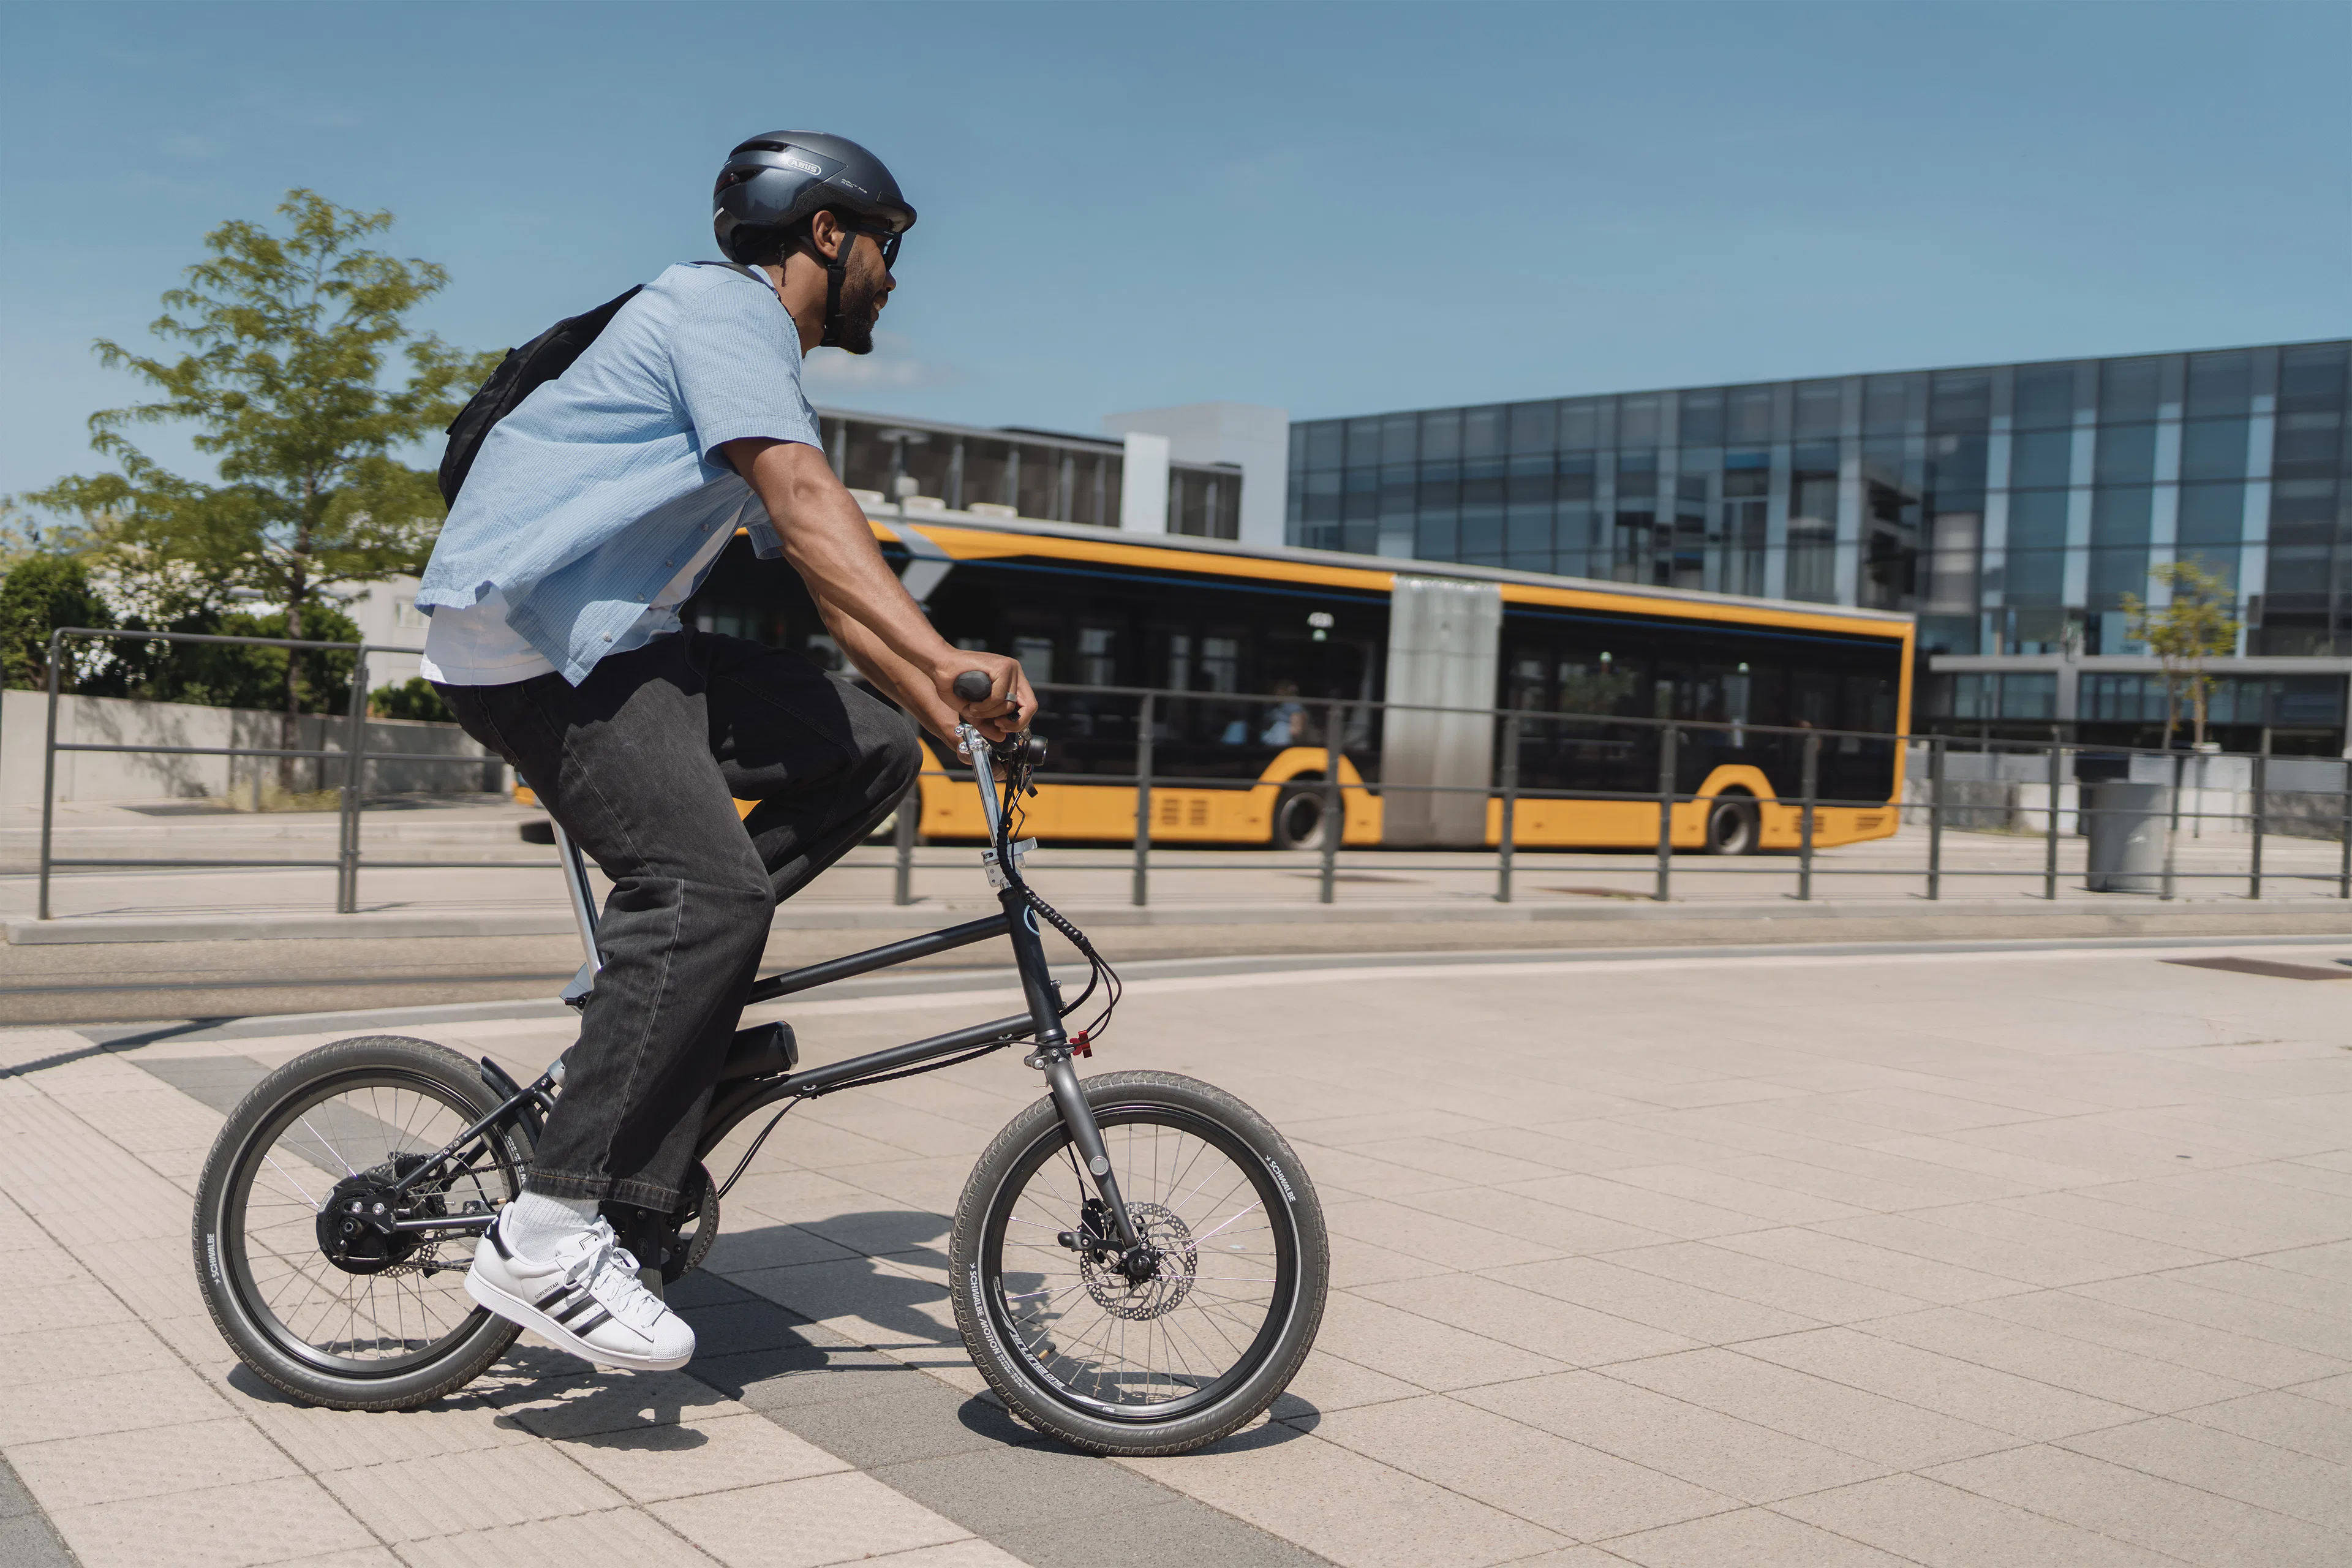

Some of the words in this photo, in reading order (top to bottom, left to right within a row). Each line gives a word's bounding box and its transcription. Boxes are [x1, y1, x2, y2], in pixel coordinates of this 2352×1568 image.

[790, 159, 817, 173] ABUS
[1269, 1161, 1296, 1202] SCHWALBE
[207, 1233, 219, 1278] SCHWALBE
[535, 1282, 559, 1299] SUPERSTAR
[970, 1270, 984, 1317] SCHWALBE
[979, 1318, 1001, 1354] MOTION
